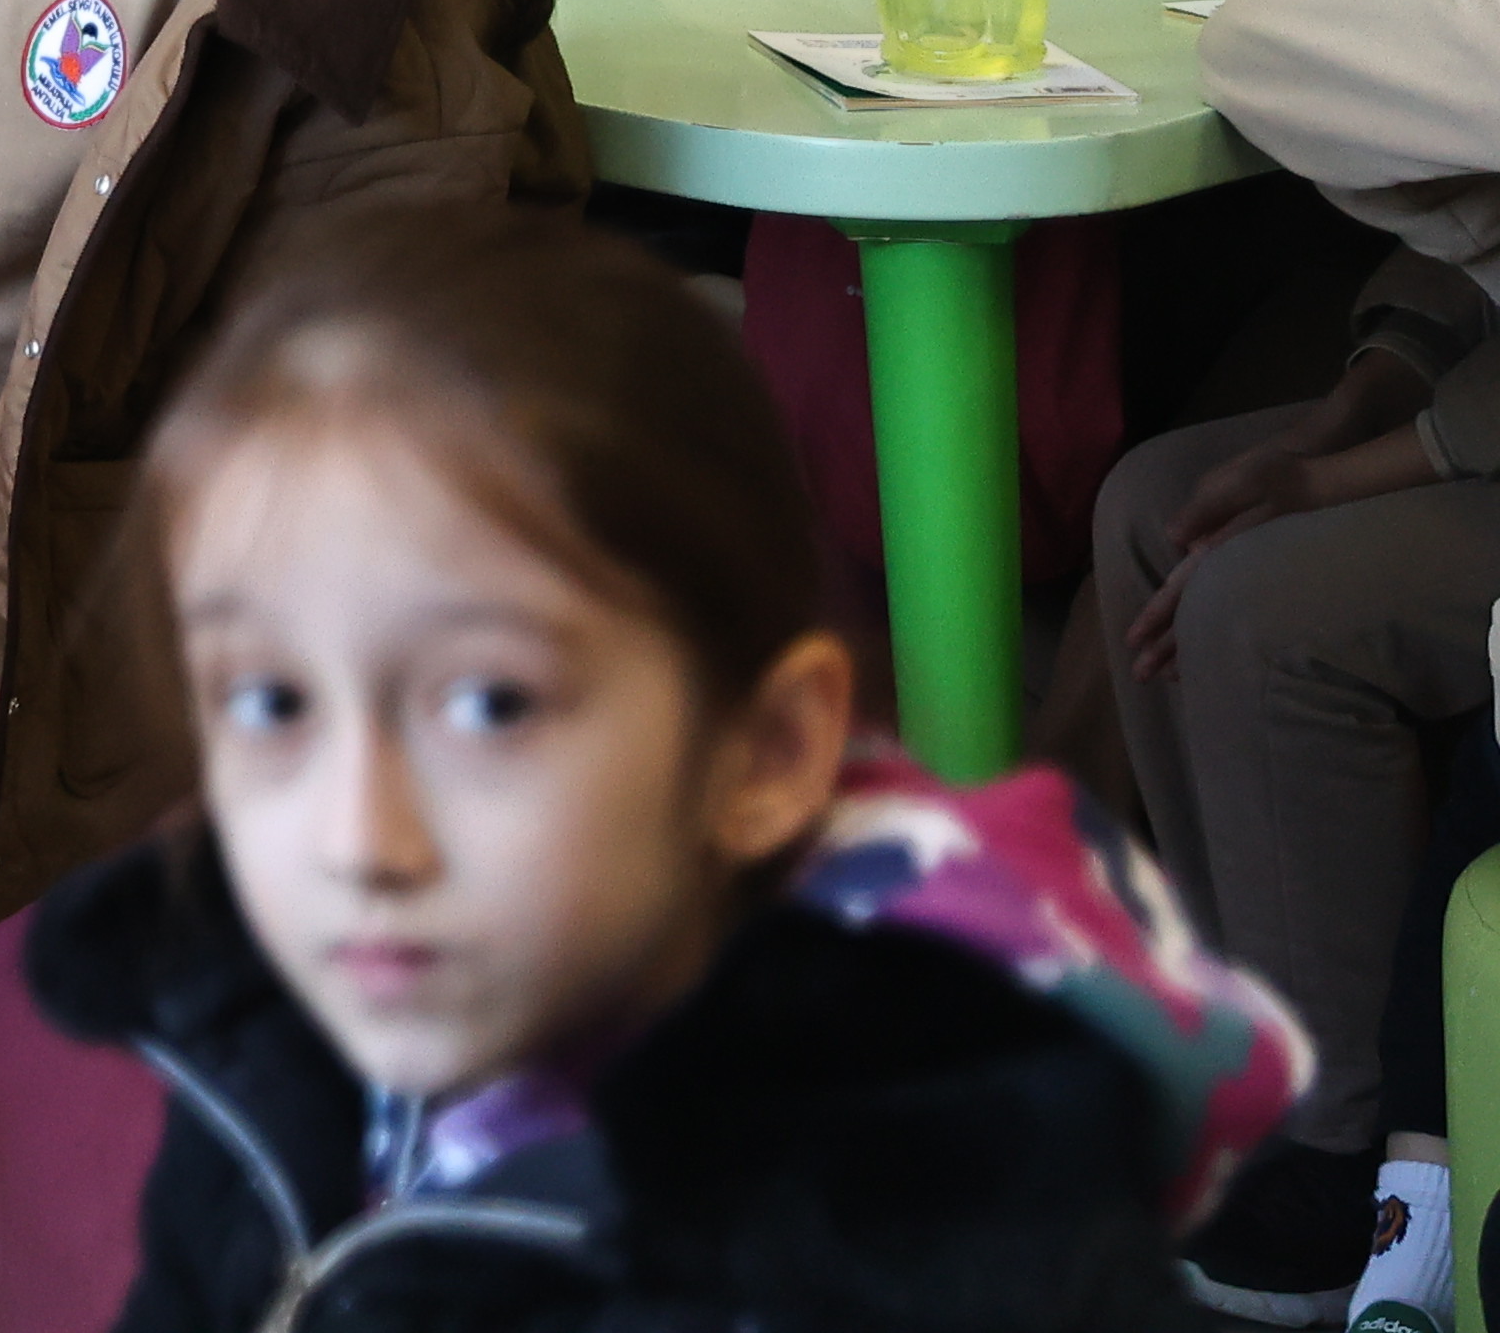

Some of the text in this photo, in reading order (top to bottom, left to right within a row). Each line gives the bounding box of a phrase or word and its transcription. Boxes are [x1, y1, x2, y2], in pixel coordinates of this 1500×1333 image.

[42, 5, 67, 31] EMEL
[93, 0, 115, 32] TANER
[31, 85, 66, 123] ANTALYA
